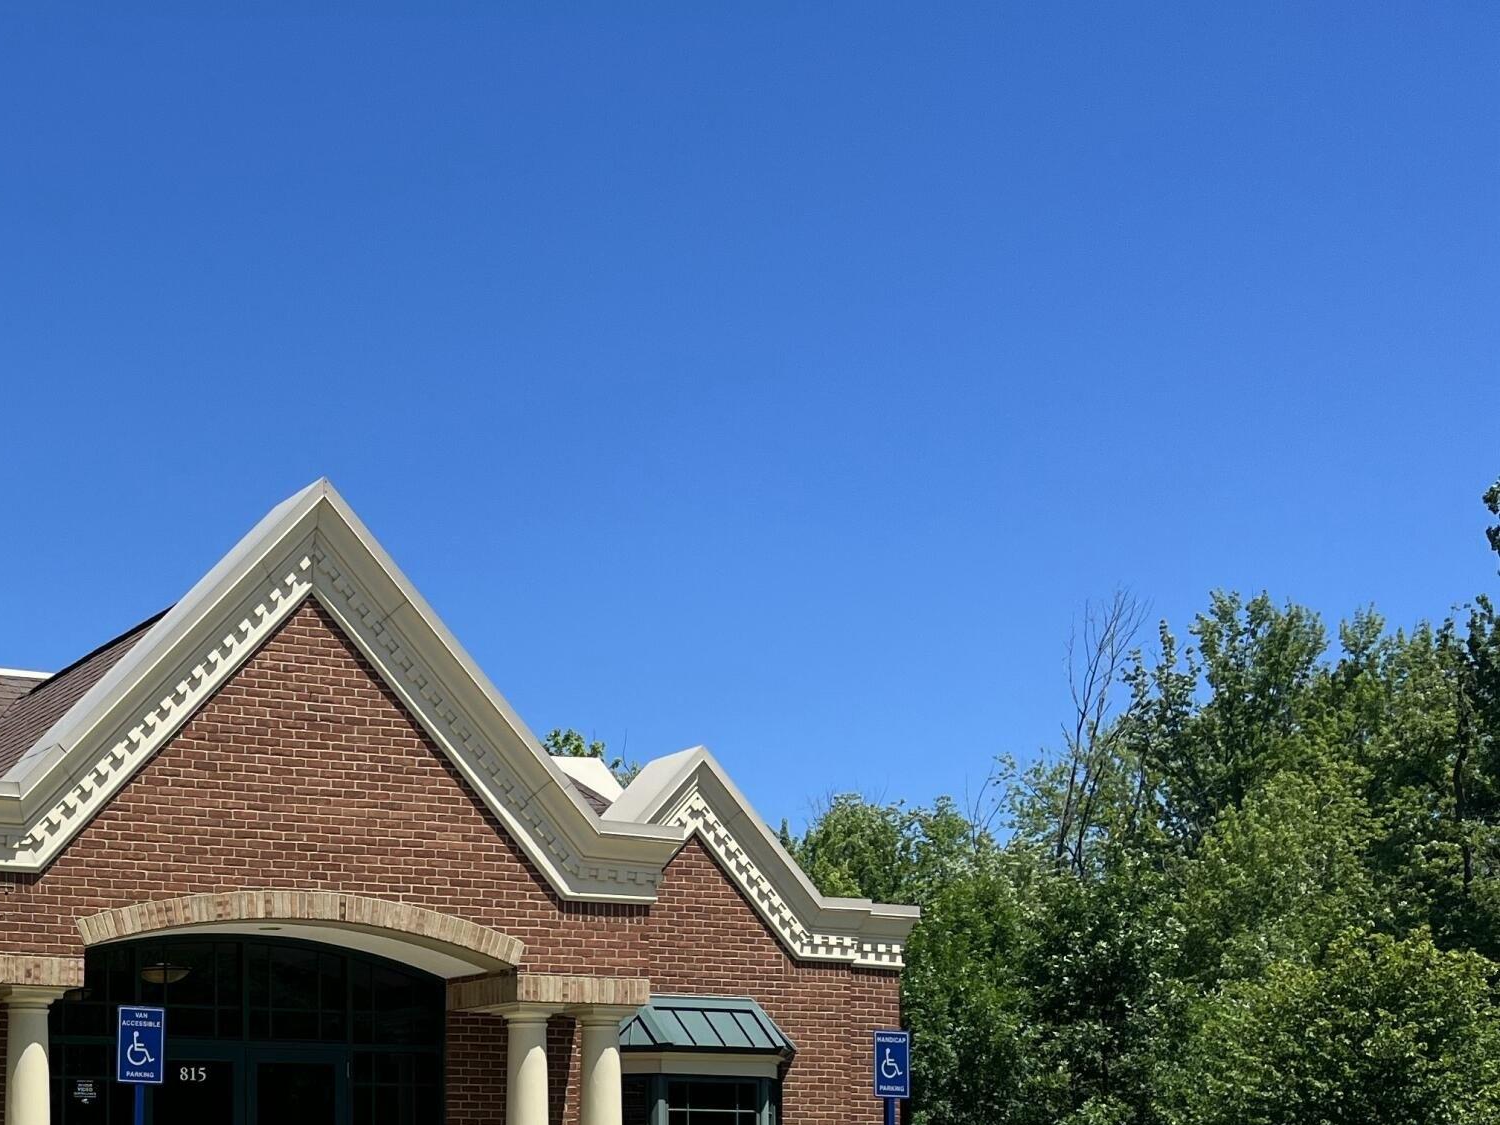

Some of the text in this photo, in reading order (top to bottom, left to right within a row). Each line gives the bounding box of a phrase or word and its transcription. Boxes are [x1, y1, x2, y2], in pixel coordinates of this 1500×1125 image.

[121, 1020, 161, 1028] ACCESSIBLE
[179, 1066, 207, 1082] 815
[879, 1084, 905, 1092] PARKING
